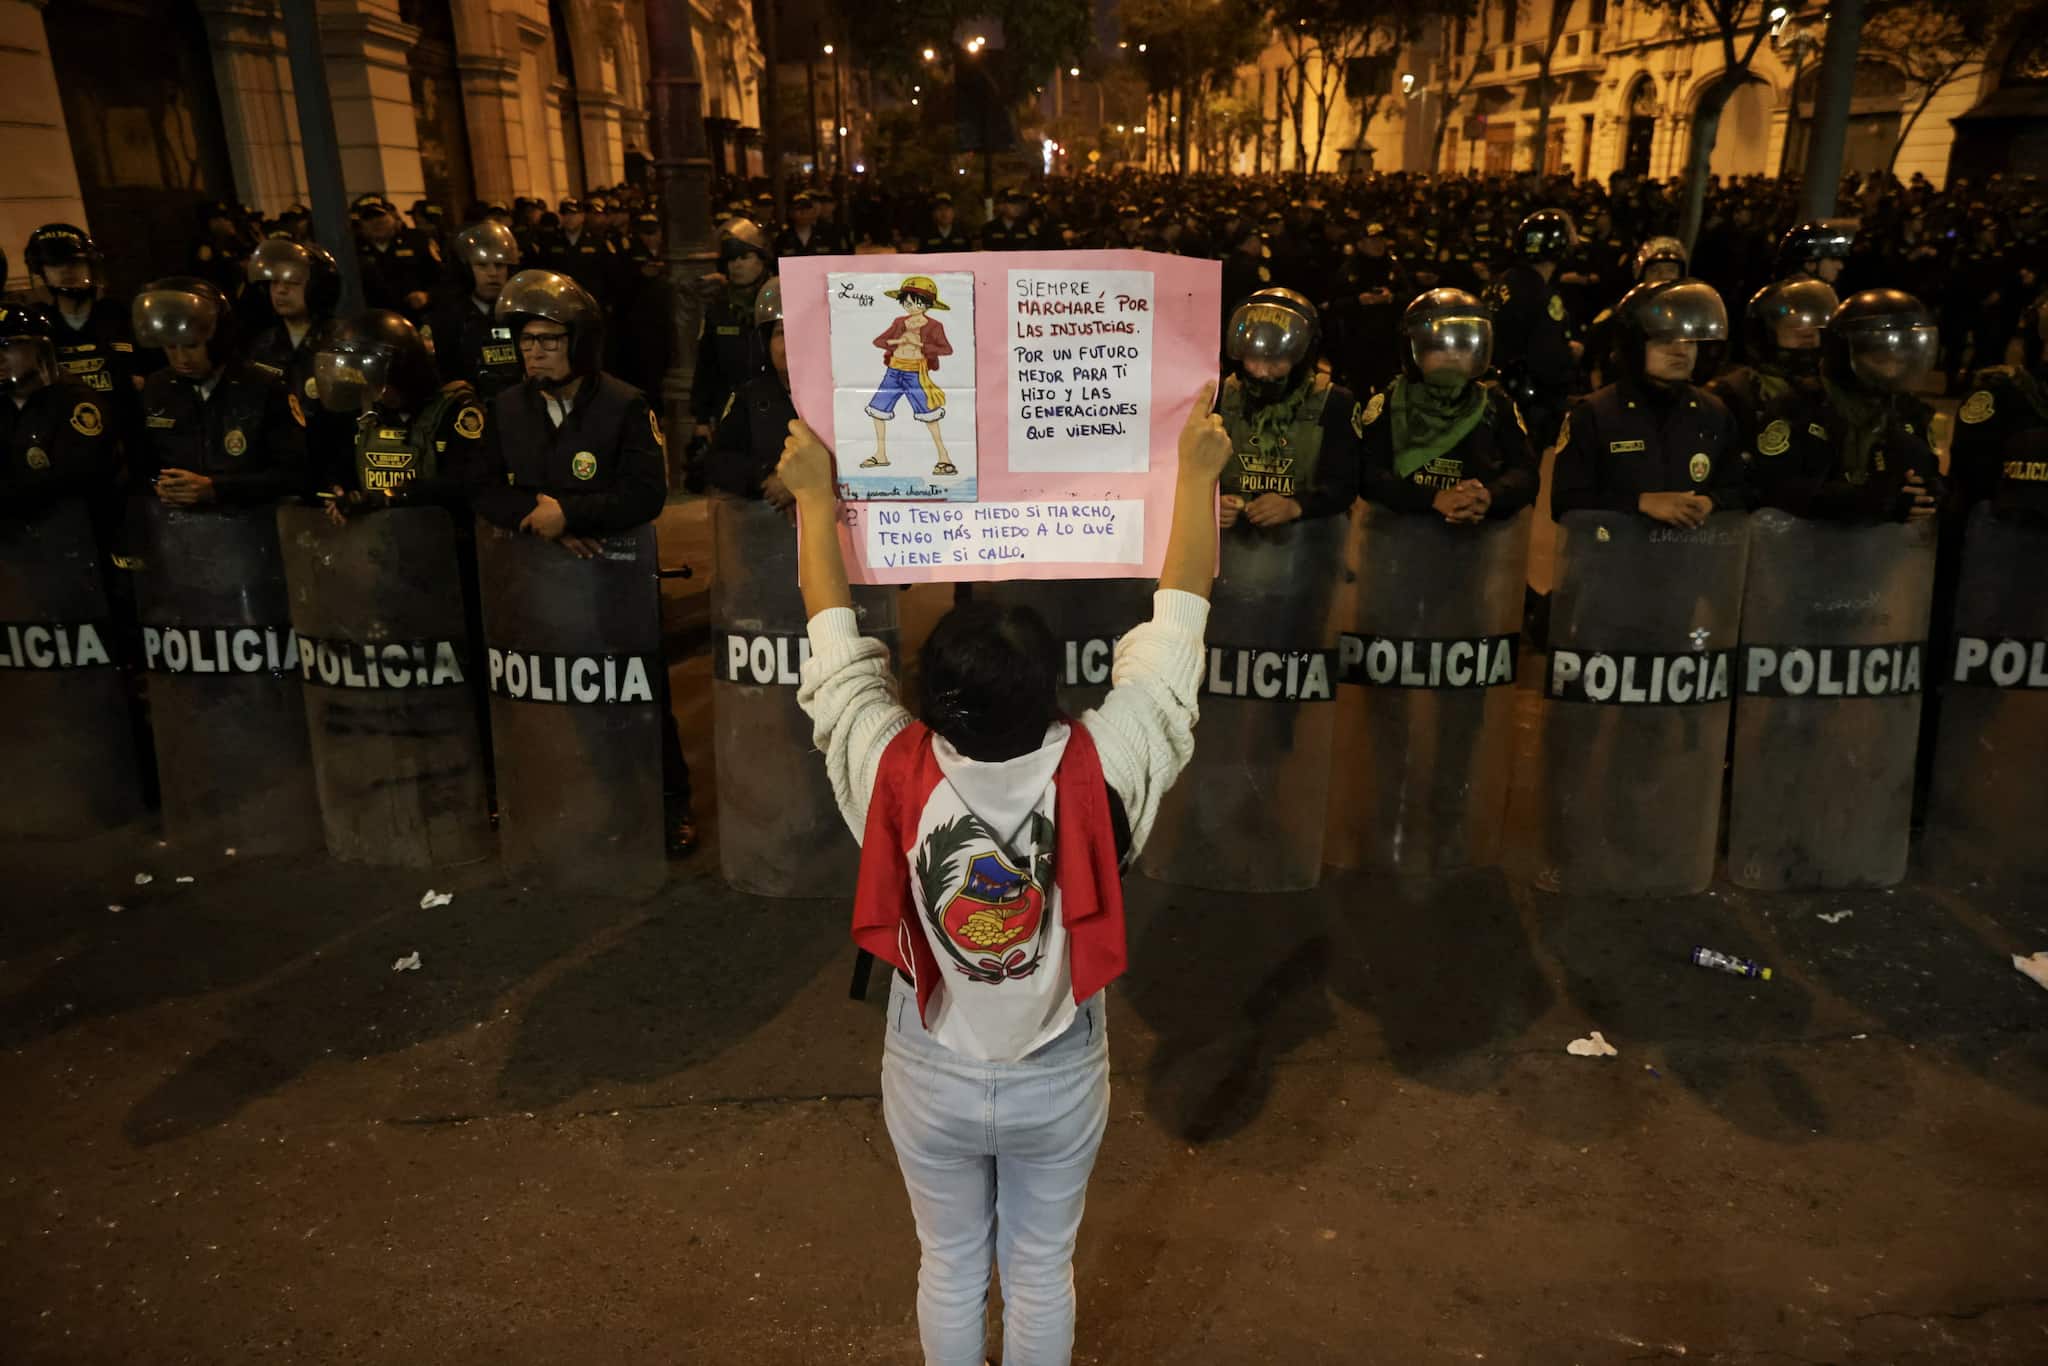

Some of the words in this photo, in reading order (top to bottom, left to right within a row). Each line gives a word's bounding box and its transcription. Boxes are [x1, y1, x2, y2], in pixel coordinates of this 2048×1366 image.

[1018, 291, 1105, 316] MARCHARÉ
[1115, 295, 1149, 312] POR
[1017, 322, 1043, 338] LAS
[1014, 346, 1044, 363] POR
[1053, 349, 1072, 361] UN
[1079, 345, 1139, 361] FUTURO
[1019, 370, 1064, 383] MEJOR
[1073, 367, 1107, 381] PARA
[1082, 387, 1111, 400] LAS
[1026, 426, 1055, 440] QUE
[1242, 475, 1292, 492] POLICIA
[879, 510, 900, 525] NO
[908, 508, 963, 524] TENGO
[975, 508, 1019, 520] MIEDO
[878, 531, 933, 546] TENGO
[944, 524, 971, 541] MÁS
[1037, 522, 1048, 536] A
[1056, 522, 1074, 535] LO
[978, 546, 1024, 560] CALLO.
[0, 624, 111, 668] ICIA
[144, 627, 299, 672] POLICIA
[298, 638, 465, 688] POLICIA
[1338, 635, 1513, 687] POLICIA
[1746, 646, 1921, 695] POLICIA
[488, 648, 654, 703] POLICIA
[1552, 650, 1728, 703] POLICIA
